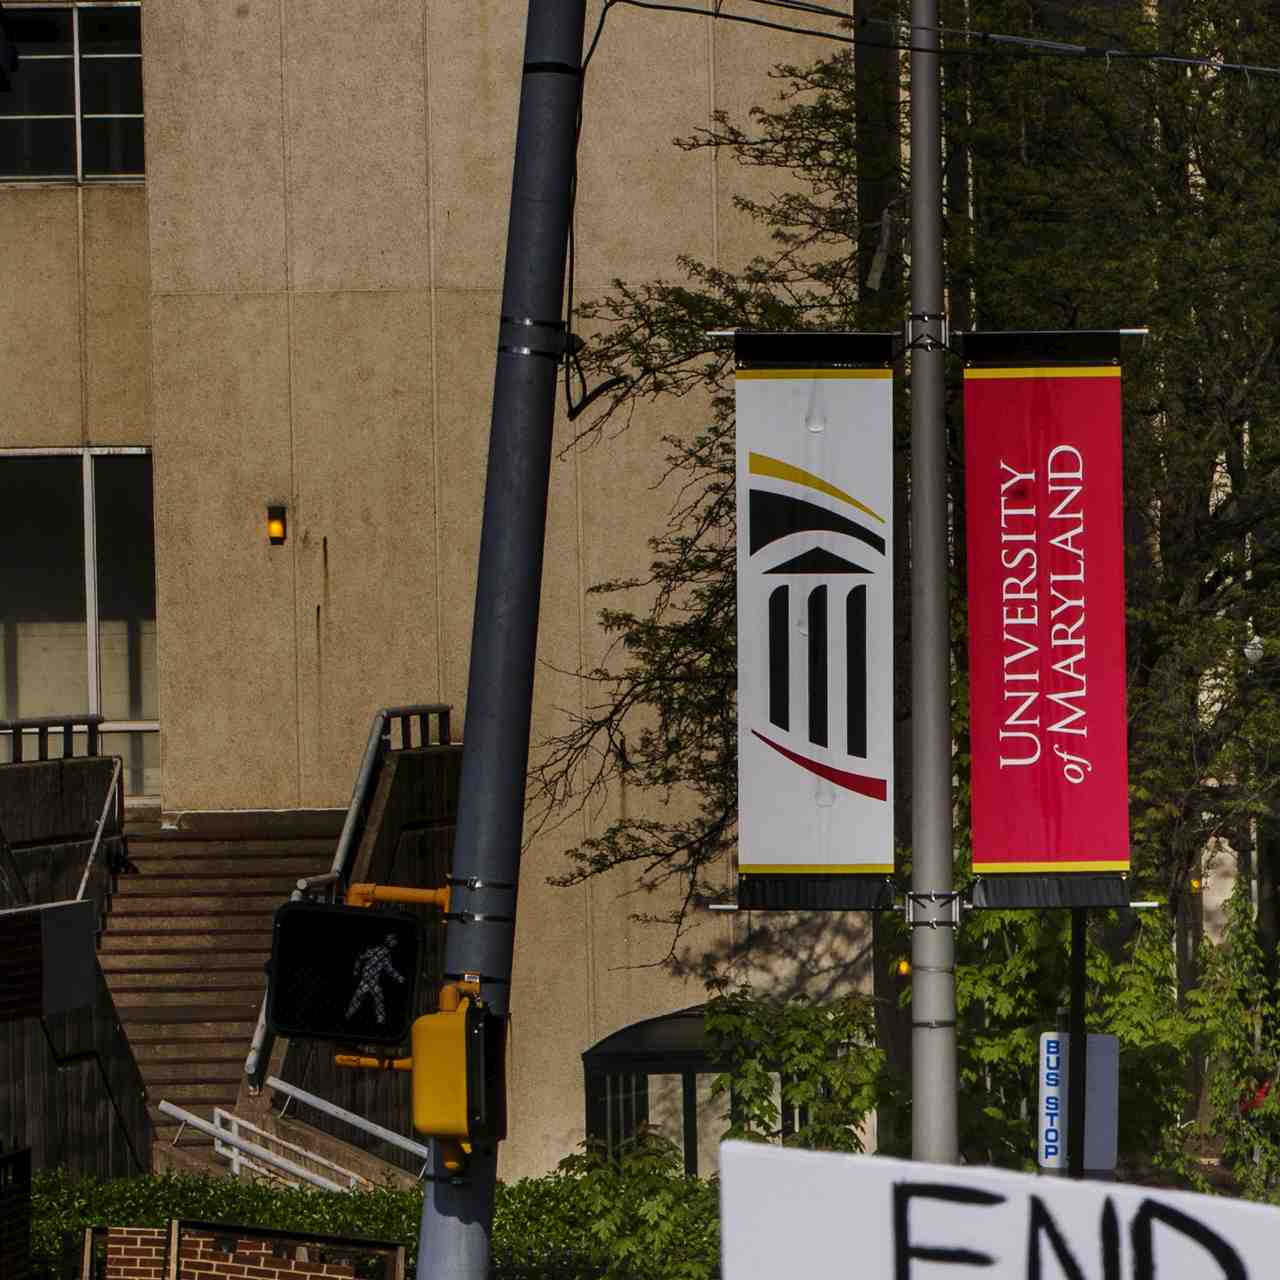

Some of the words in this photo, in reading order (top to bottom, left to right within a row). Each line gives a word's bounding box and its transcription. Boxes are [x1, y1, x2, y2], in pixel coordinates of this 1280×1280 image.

[1000, 461, 1042, 769] UNIVERSITY
[1046, 443, 1089, 738] MARYLAND
[1062, 745, 1092, 784] of
[1045, 1039, 1061, 1088] BUS
[1043, 1094, 1060, 1161] STOP
